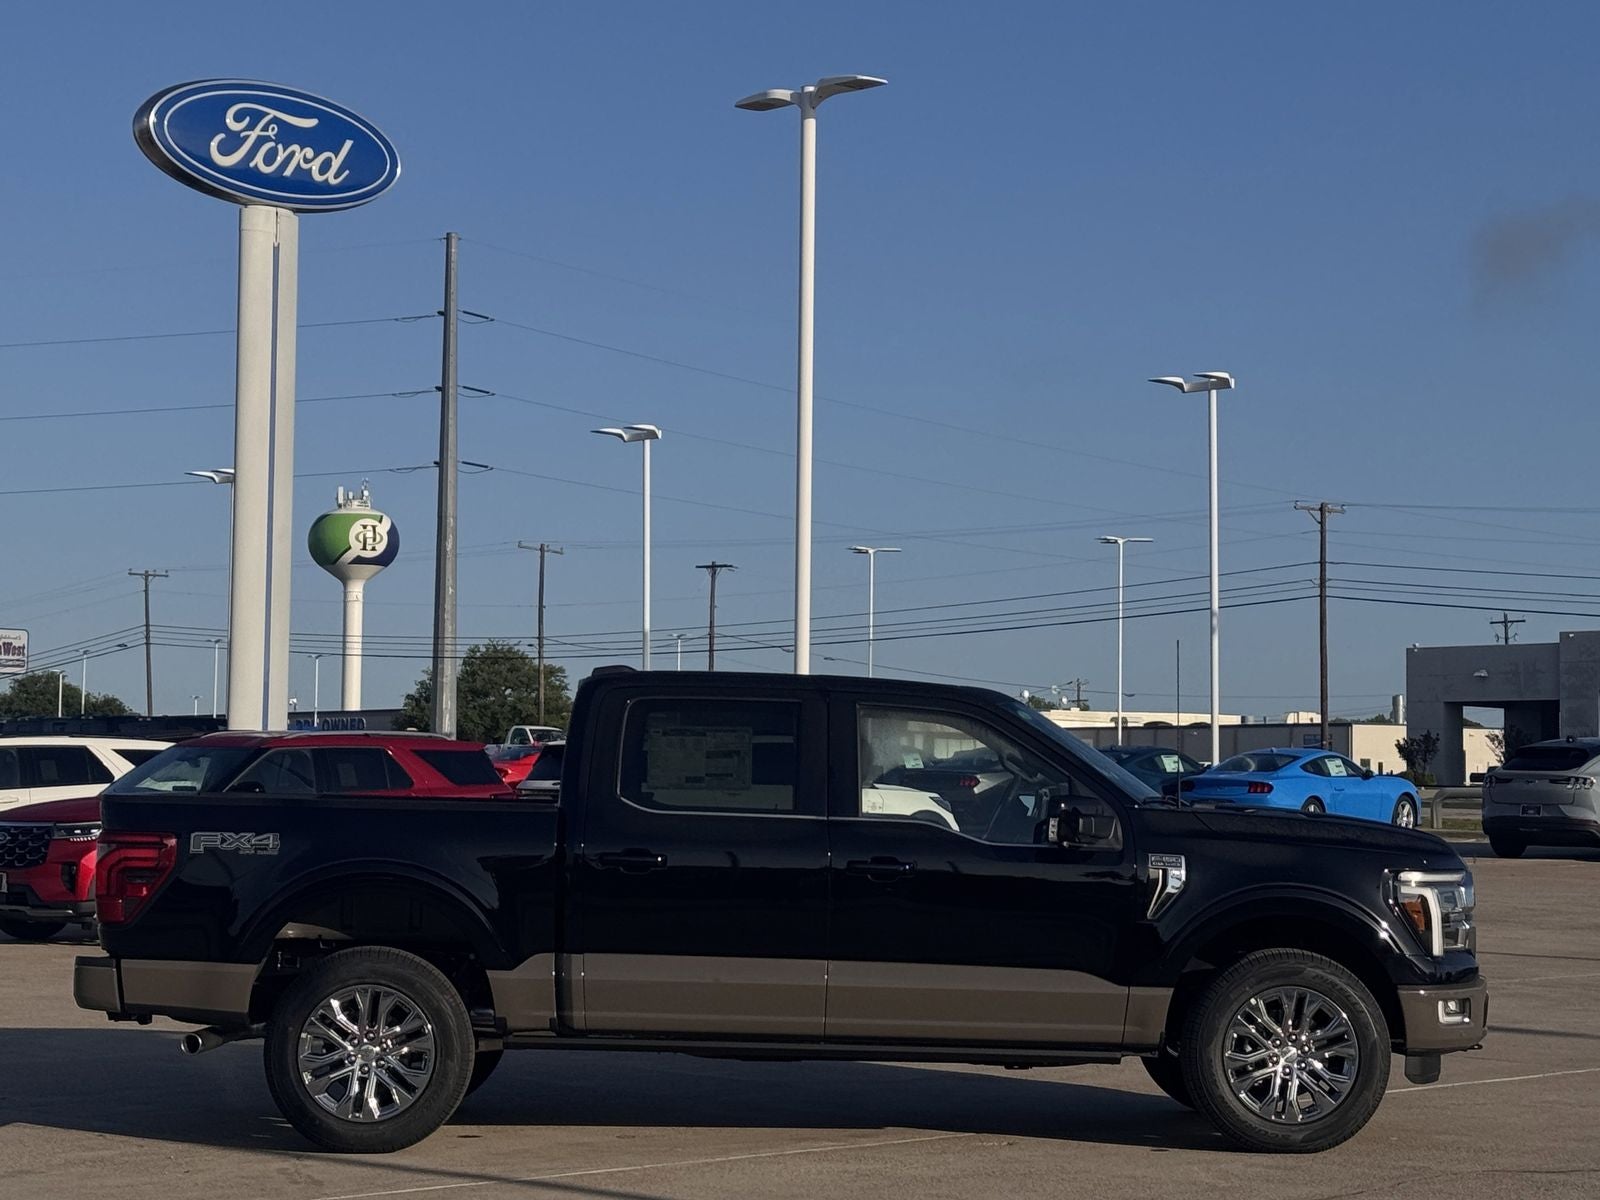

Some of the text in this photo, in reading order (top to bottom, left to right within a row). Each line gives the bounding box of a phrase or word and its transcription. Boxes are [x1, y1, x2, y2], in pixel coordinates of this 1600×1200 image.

[210, 103, 354, 185] Ford
[322, 717, 367, 731] OWNED
[190, 831, 281, 854] FX4
